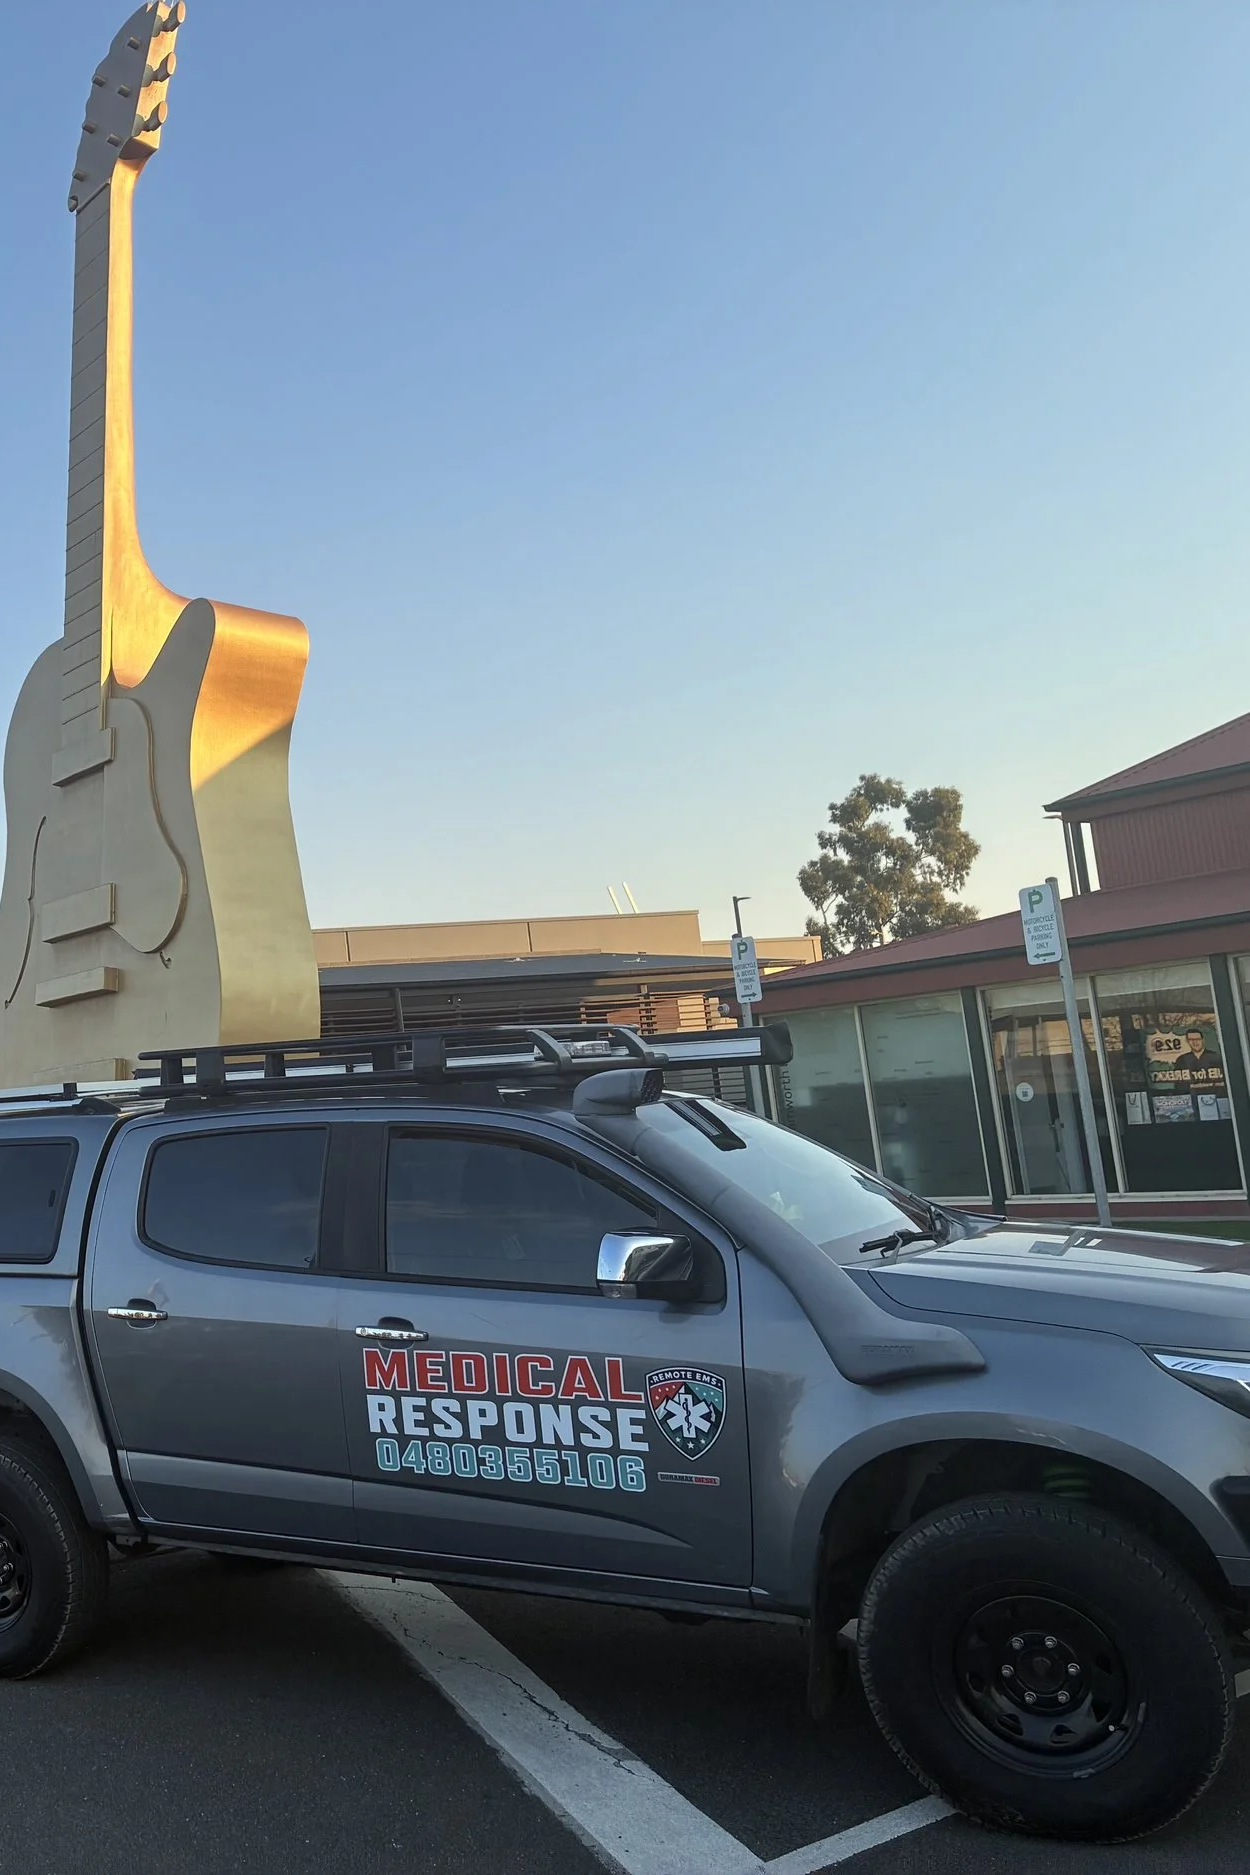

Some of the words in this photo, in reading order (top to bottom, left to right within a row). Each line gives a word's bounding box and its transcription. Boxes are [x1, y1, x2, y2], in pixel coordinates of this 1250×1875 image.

[1028, 890, 1043, 913] P
[1024, 914, 1054, 925] MOTORCYCLE
[1034, 923, 1054, 933] BICYCLE
[1031, 932, 1052, 941] PARKING
[737, 942, 748, 960] P
[362, 1348, 646, 1404] MEDICAL
[652, 1371, 692, 1383] REMOTE
[696, 1373, 718, 1386] EMS
[366, 1394, 649, 1451] RESPONSE
[375, 1438, 647, 1492] 0480355106
